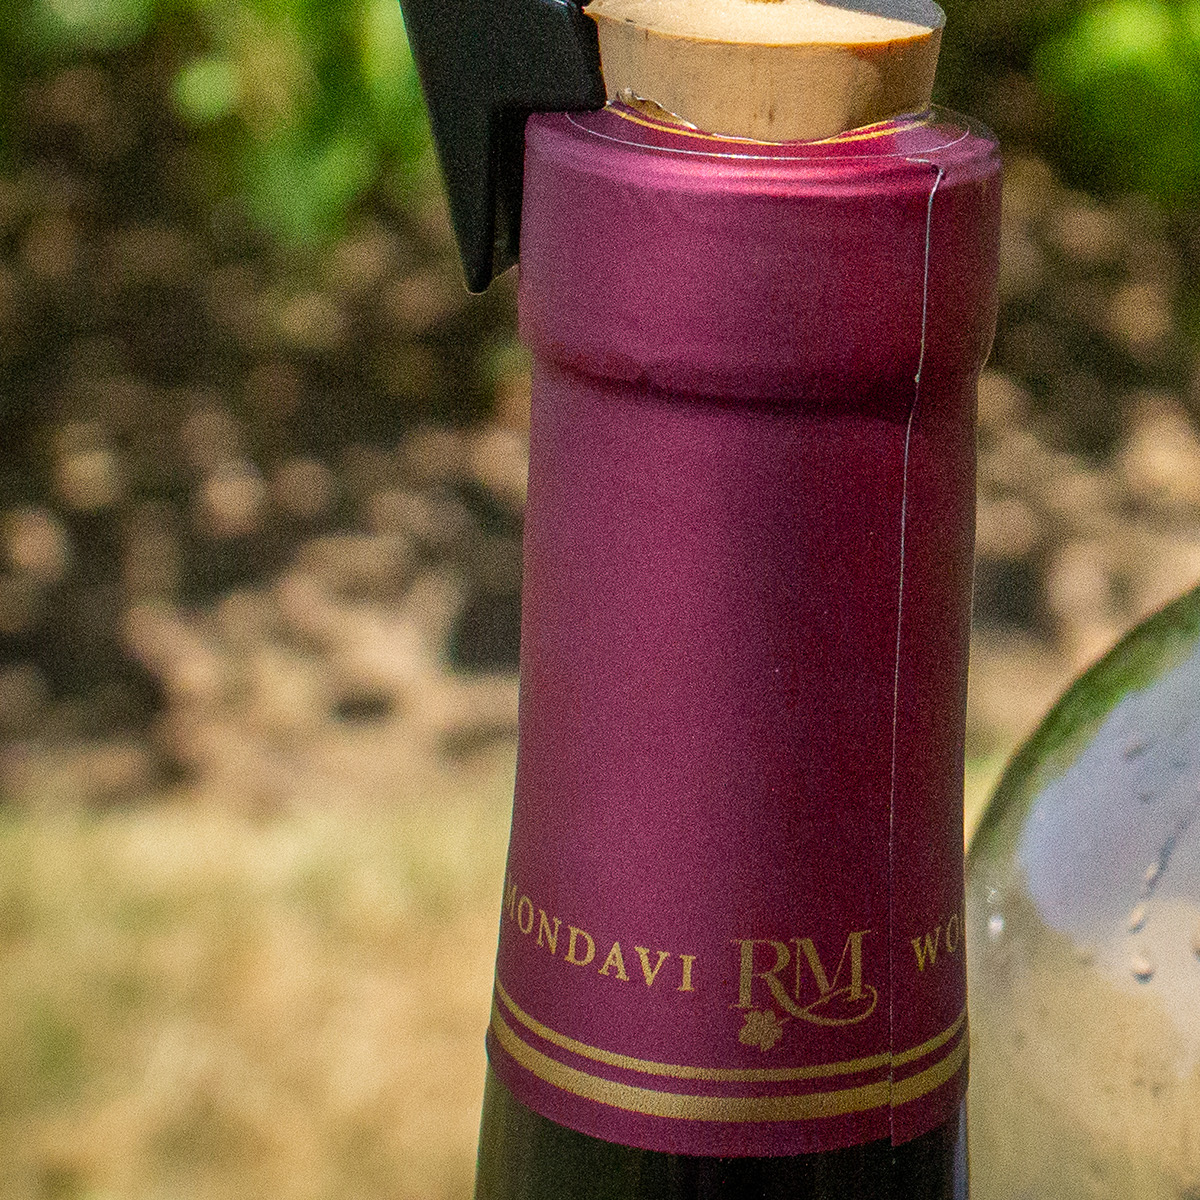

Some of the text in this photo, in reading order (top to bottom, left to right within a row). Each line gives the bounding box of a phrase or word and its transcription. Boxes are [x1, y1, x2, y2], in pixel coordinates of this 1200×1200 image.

[504, 875, 964, 1027] MONDAVI RM WO
